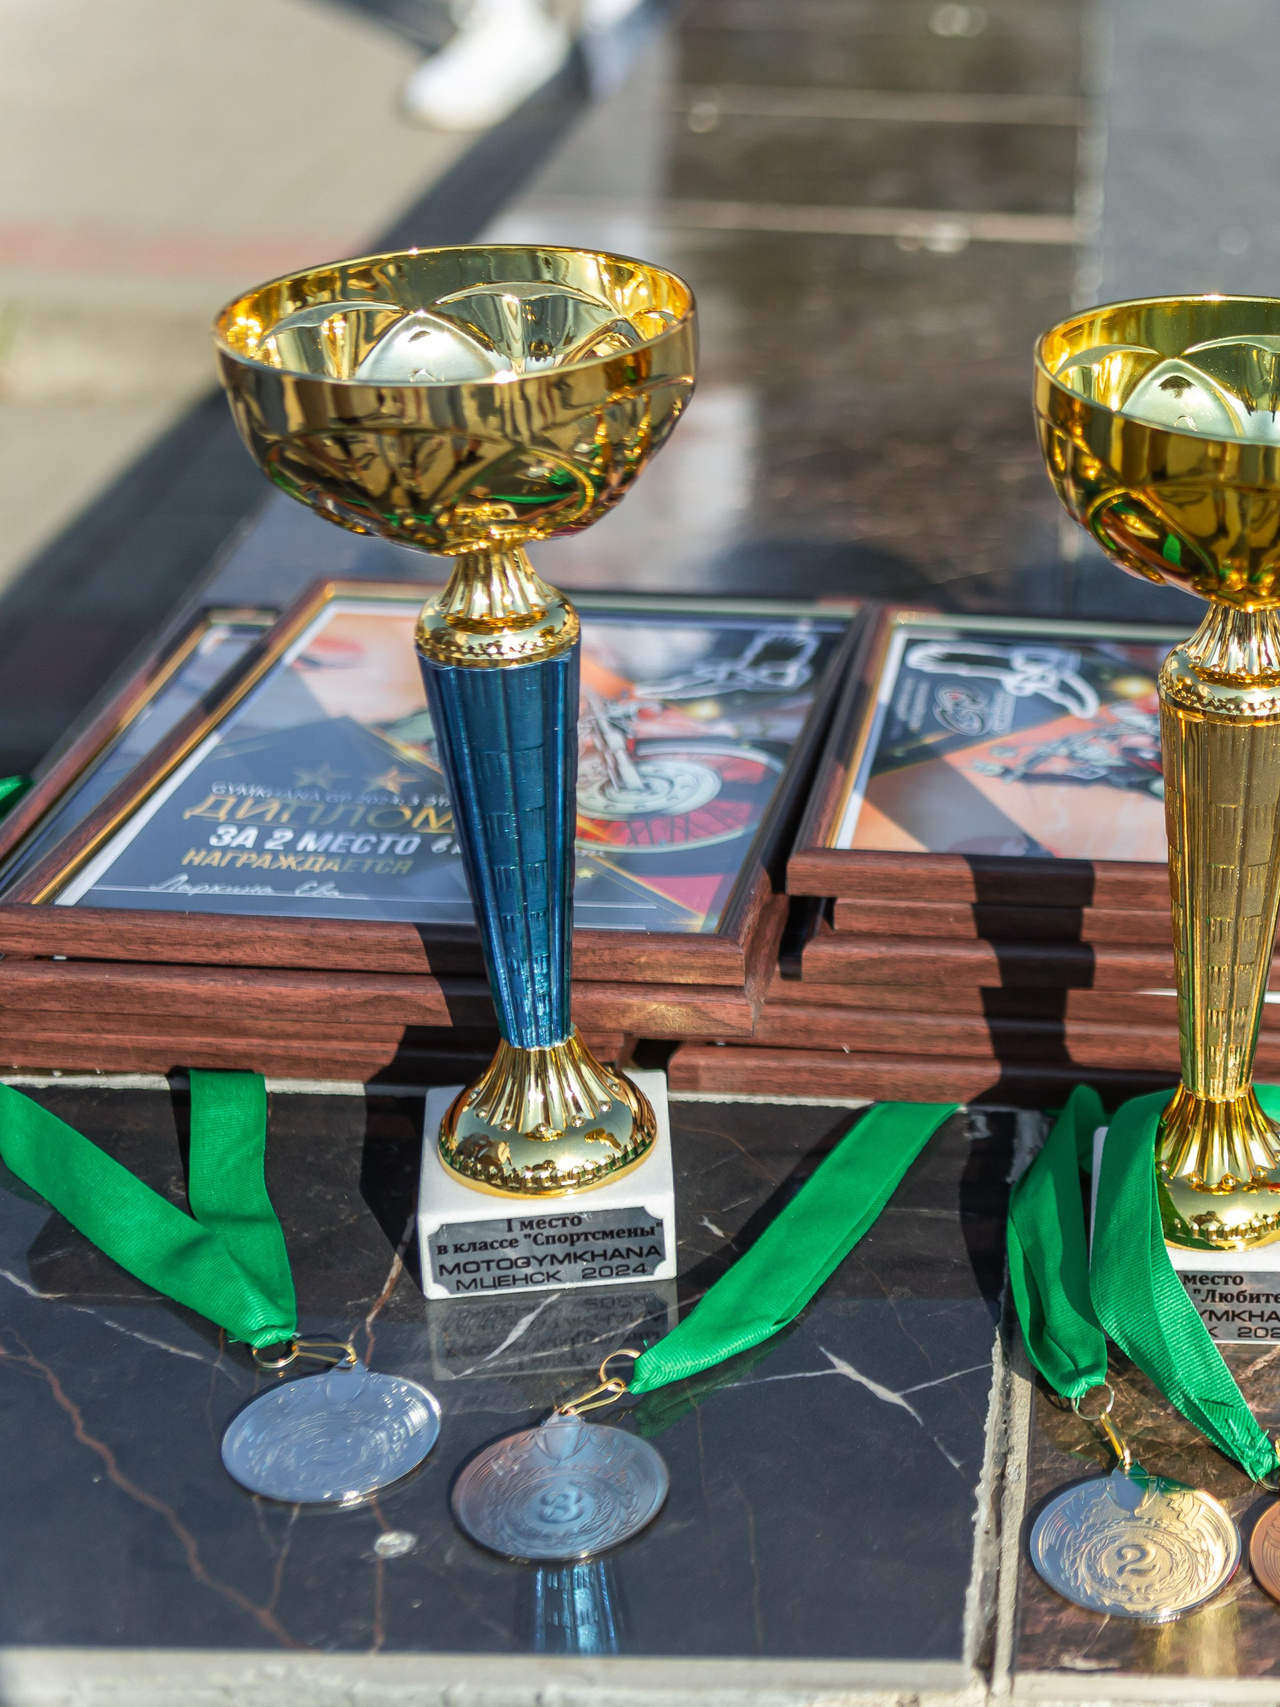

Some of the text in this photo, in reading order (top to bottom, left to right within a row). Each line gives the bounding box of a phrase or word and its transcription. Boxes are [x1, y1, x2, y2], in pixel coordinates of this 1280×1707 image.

[183, 793, 455, 830] ДИПЛОМ
[209, 824, 259, 849] ЗА
[264, 827, 295, 850] 2
[296, 830, 422, 856] МЕСТО
[181, 847, 414, 875] НАГРАЖДАЕТСЯ
[436, 1221, 663, 1256] в классе "Спортсмены"
[520, 1214, 582, 1232] место
[438, 1245, 662, 1277] MOTOGYMKHANA
[456, 1262, 648, 1291] МЦЕНСК 2024
[1182, 1274, 1244, 1286] место
[1114, 1543, 1159, 1577] 2
